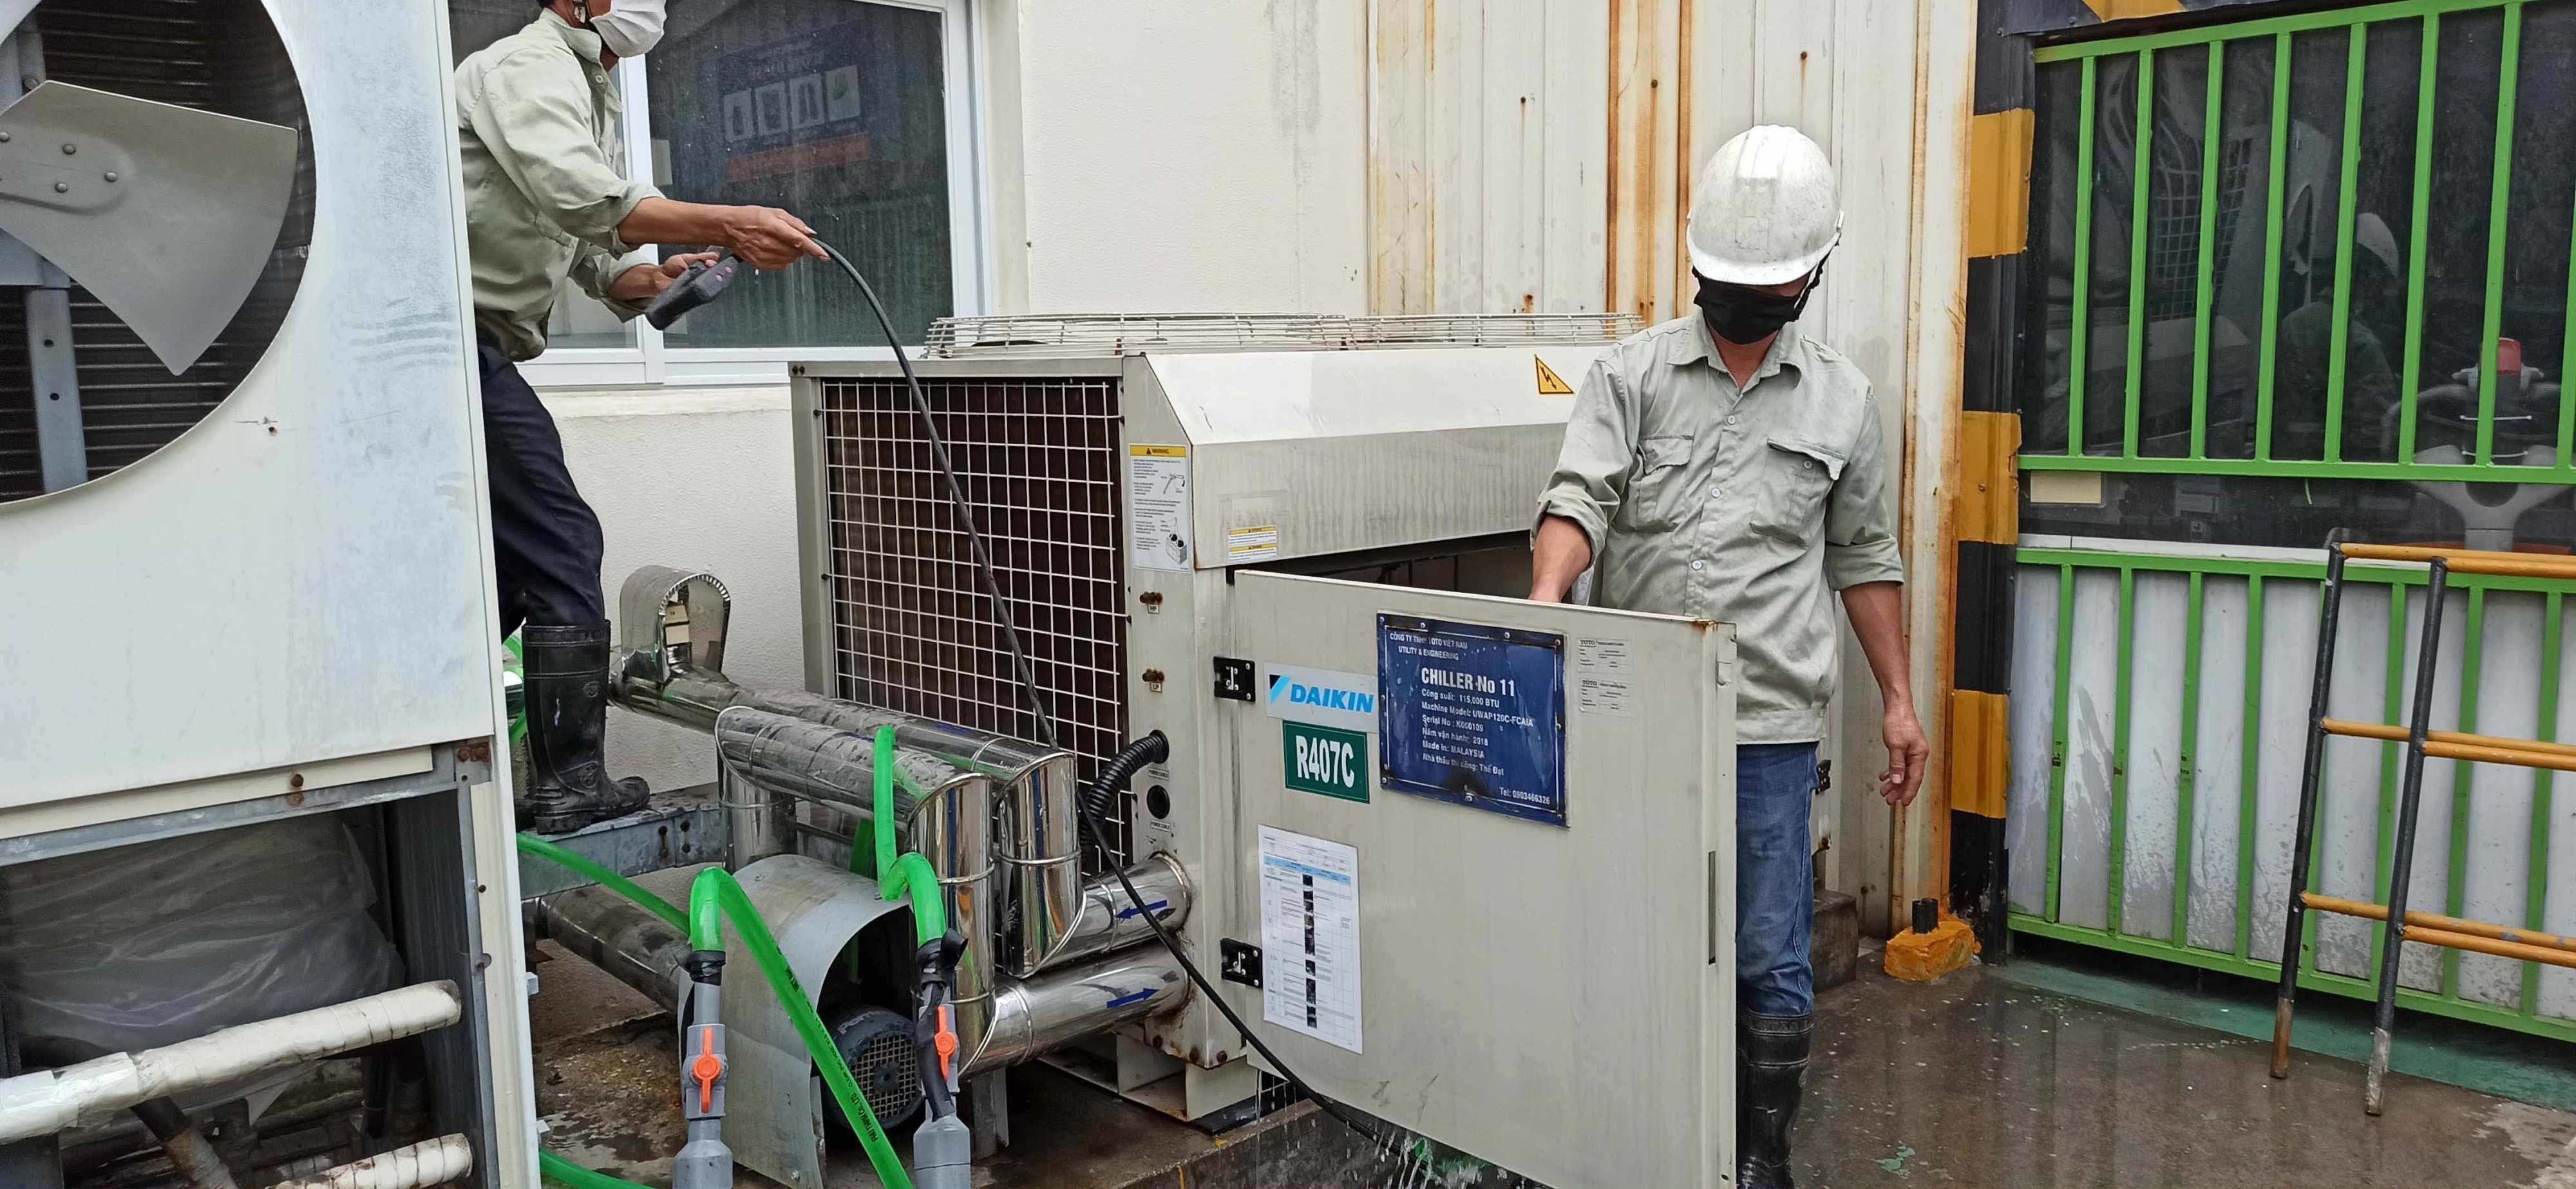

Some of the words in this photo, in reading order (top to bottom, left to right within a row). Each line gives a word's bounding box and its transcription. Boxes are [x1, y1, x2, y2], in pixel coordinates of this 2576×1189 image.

[1399, 646, 1417, 654] UTILITY
[1423, 648, 1459, 660] ENGINEERING
[1421, 668, 1473, 691] CHILLER
[1477, 675, 1495, 694] No
[1499, 679, 1514, 697] 11
[1290, 684, 1374, 713] DAIKIN
[1459, 695, 1484, 705] 115,000
[1485, 698, 1500, 707] BTU
[1422, 701, 1448, 713] Machine
[1450, 706, 1471, 716] Model:
[1422, 714, 1440, 725] Serial
[1473, 736, 1488, 746] 2018
[1423, 740, 1439, 750] Made
[1450, 745, 1485, 758] MALAYSIA
[1296, 735, 1354, 788] R407C
[1499, 787, 1511, 798] Tel:
